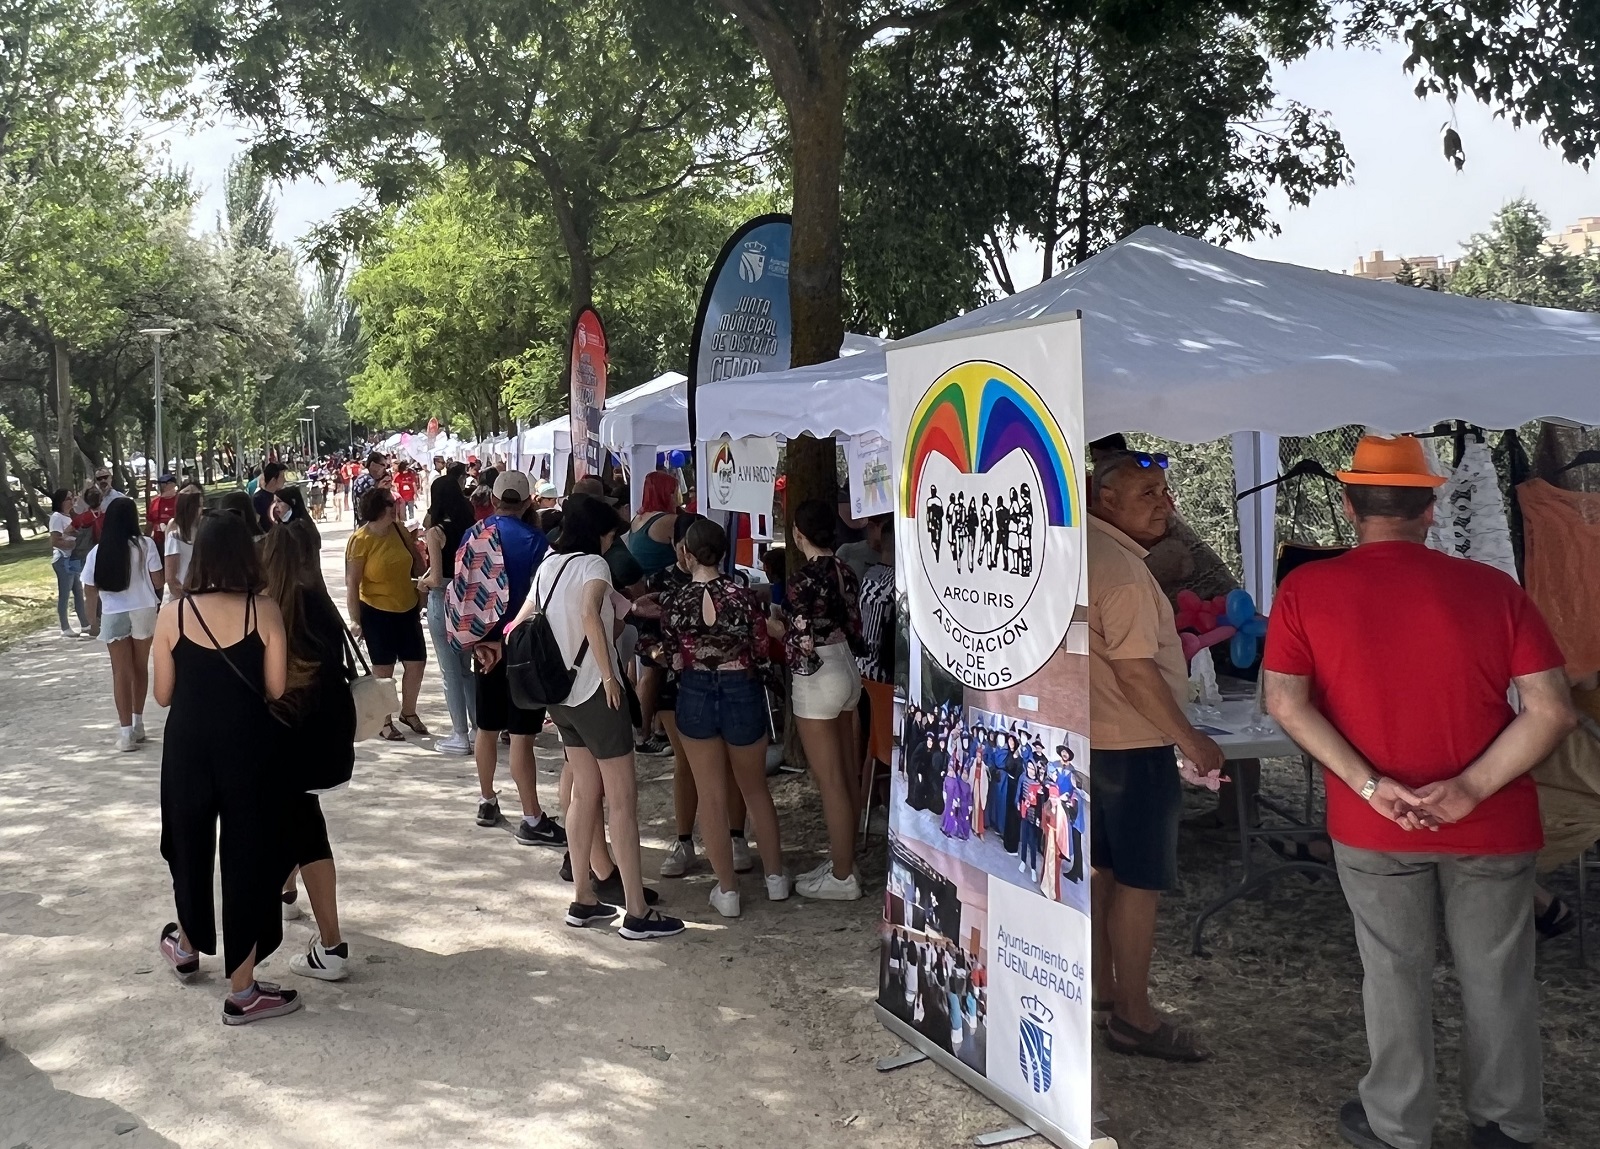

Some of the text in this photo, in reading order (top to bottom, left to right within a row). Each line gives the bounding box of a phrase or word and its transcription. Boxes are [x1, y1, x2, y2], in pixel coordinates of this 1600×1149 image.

[734, 296, 770, 315] JUNTA
[719, 313, 777, 336] MUNICIPAL
[711, 333, 778, 355] DE DISTRITO
[943, 586, 1014, 609] ARCO IRIS
[932, 608, 1029, 653] ASOCIACIÓN
[946, 652, 1012, 687] VECINOS
[966, 653, 985, 670] DE
[997, 924, 1084, 981] Ayuntamiento de
[997, 946, 1082, 1006] FUENLABRADA
